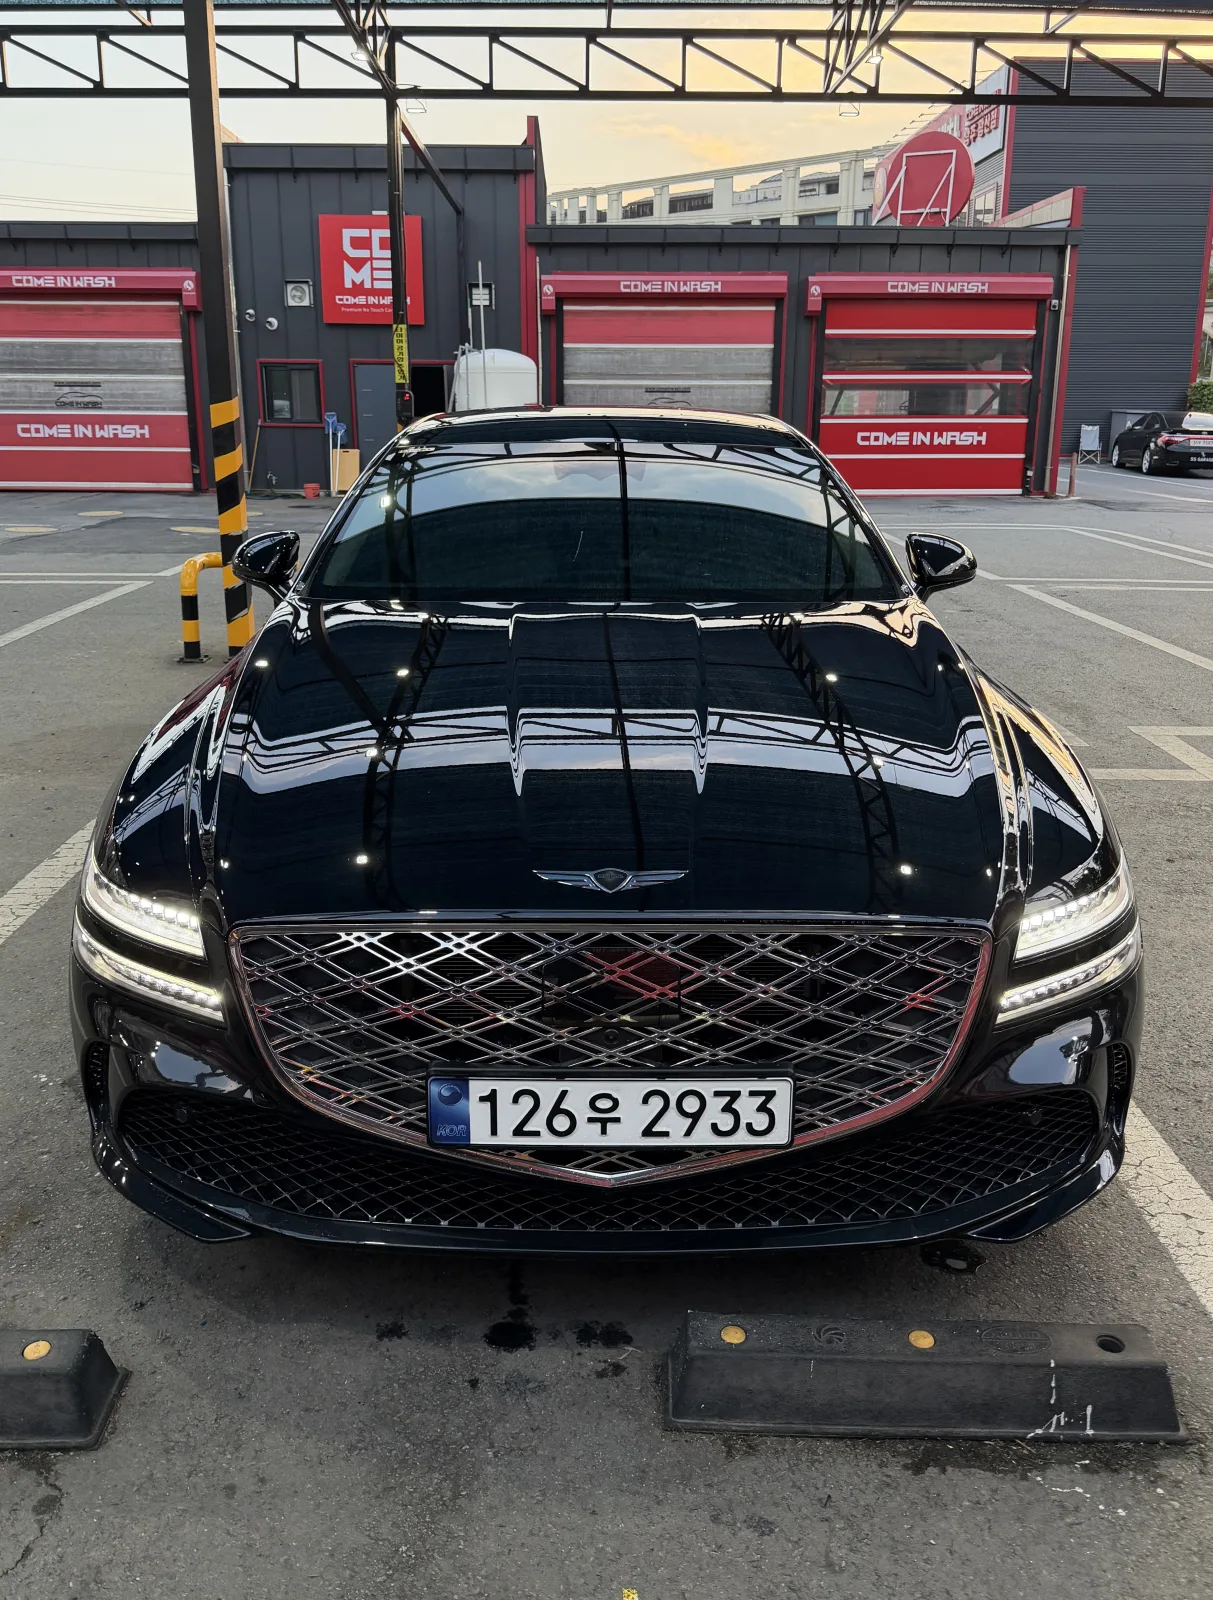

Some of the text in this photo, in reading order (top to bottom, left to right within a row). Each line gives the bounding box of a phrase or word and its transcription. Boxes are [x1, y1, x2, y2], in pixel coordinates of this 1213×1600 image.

[12, 275, 116, 287] COME IN WASH
[620, 281, 722, 292] COME IN WASH
[887, 281, 989, 293] COME IN WASH
[335, 295, 367, 305] COME
[367, 296, 379, 305] IN
[17, 424, 150, 439] COME IN WASH
[856, 432, 987, 445] COME IN WASH
[478, 1089, 777, 1137] 126우 2933
[436, 1124, 467, 1137] KOR
